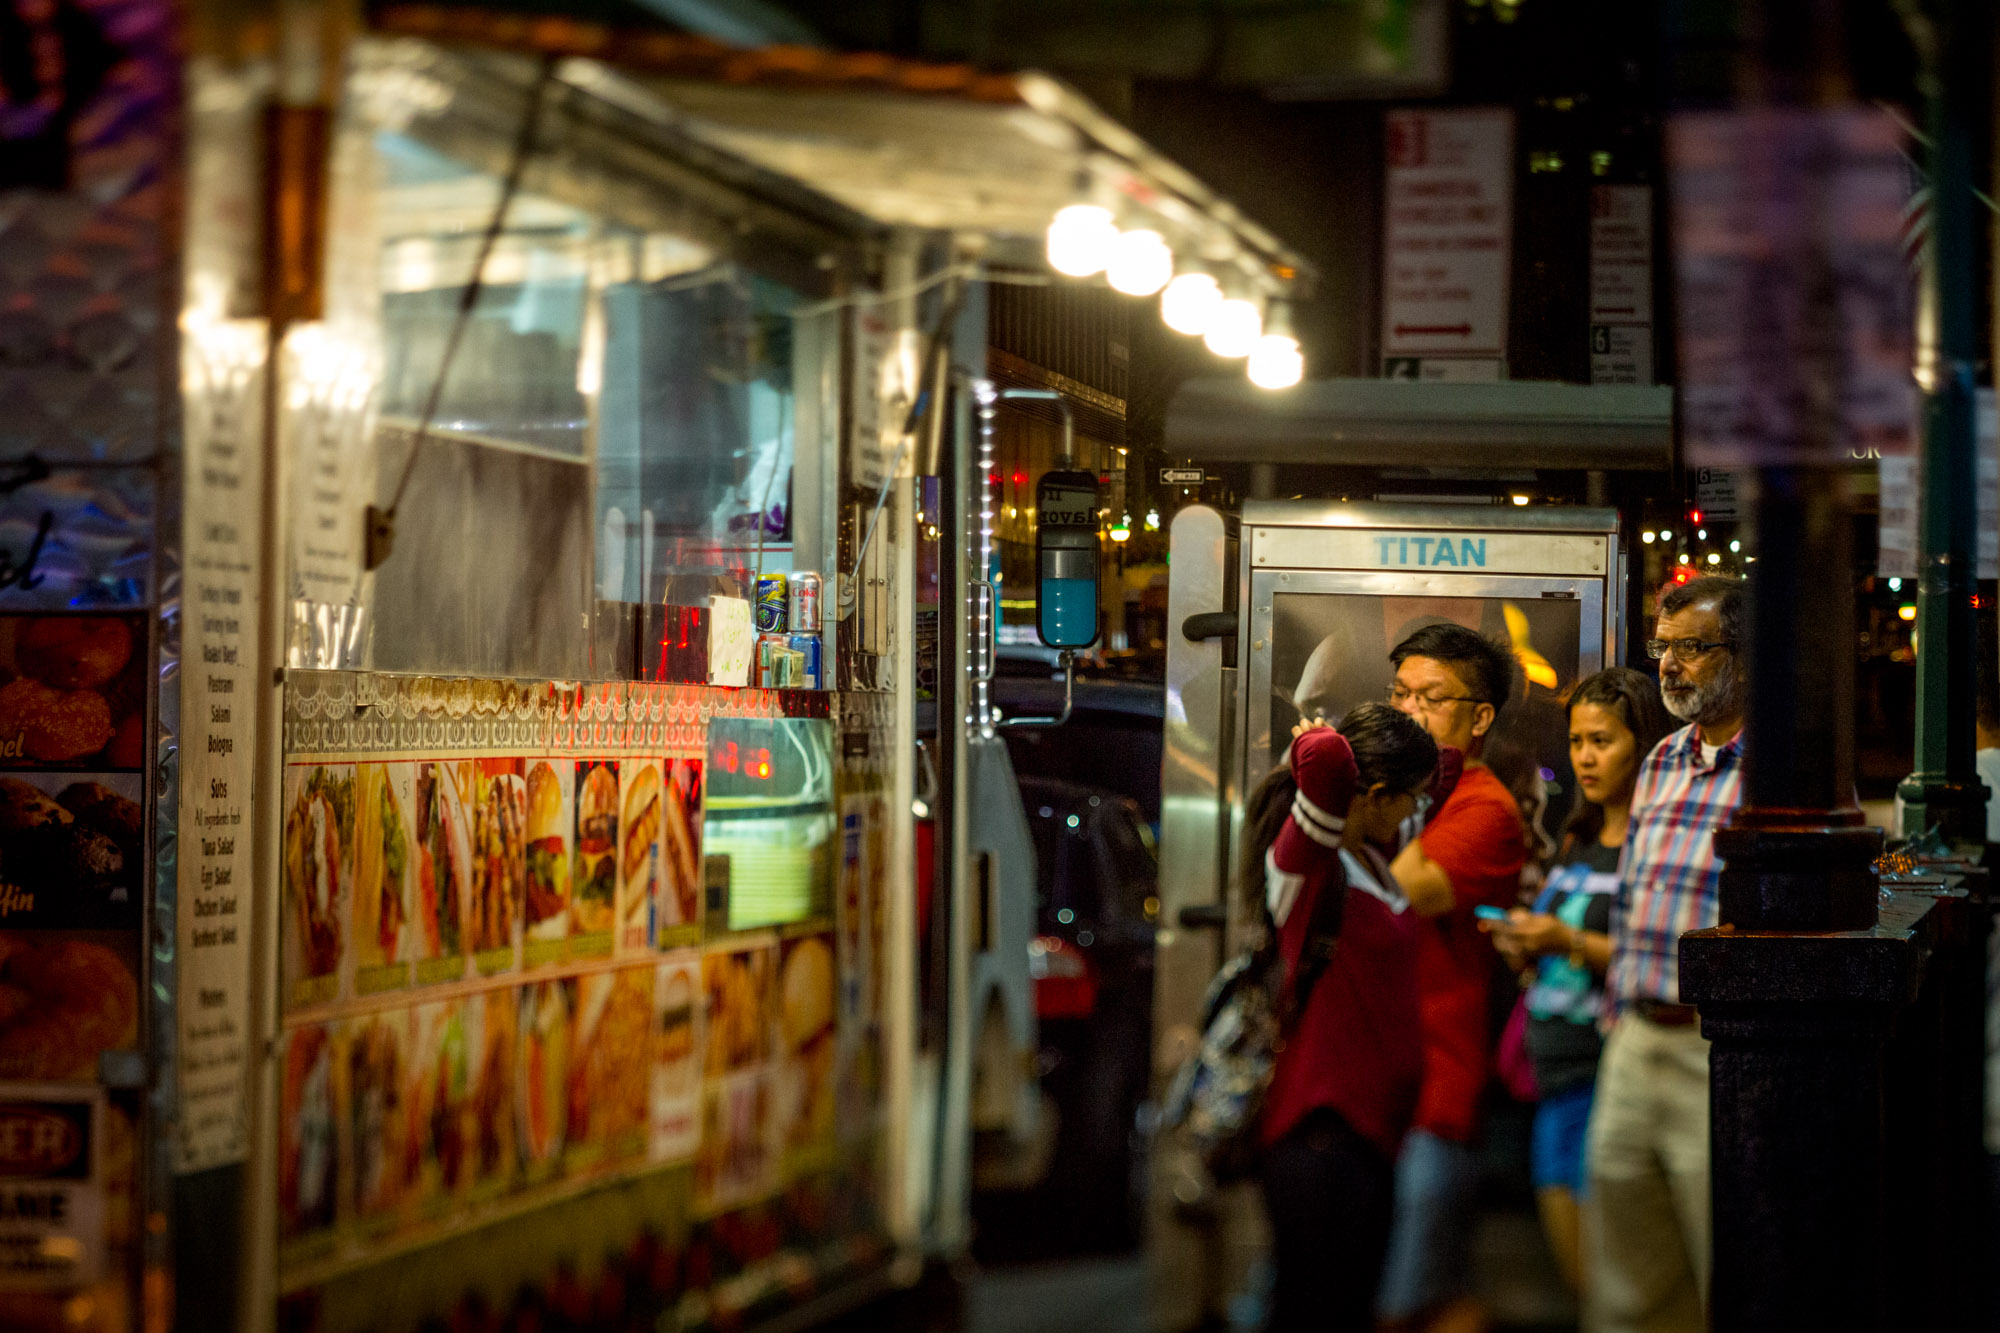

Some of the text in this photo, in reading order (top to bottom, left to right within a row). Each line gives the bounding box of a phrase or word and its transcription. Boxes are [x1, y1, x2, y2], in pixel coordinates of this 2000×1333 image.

[1374, 536, 1486, 567] TITAN
[792, 587, 818, 598] Coke
[208, 675, 234, 693] Pastrami
[211, 705, 231, 723] Salami
[208, 735, 233, 757] Bologna
[211, 778, 228, 799] Subs
[201, 836, 235, 856] Tuna Salad
[200, 865, 232, 890] Egg Salad
